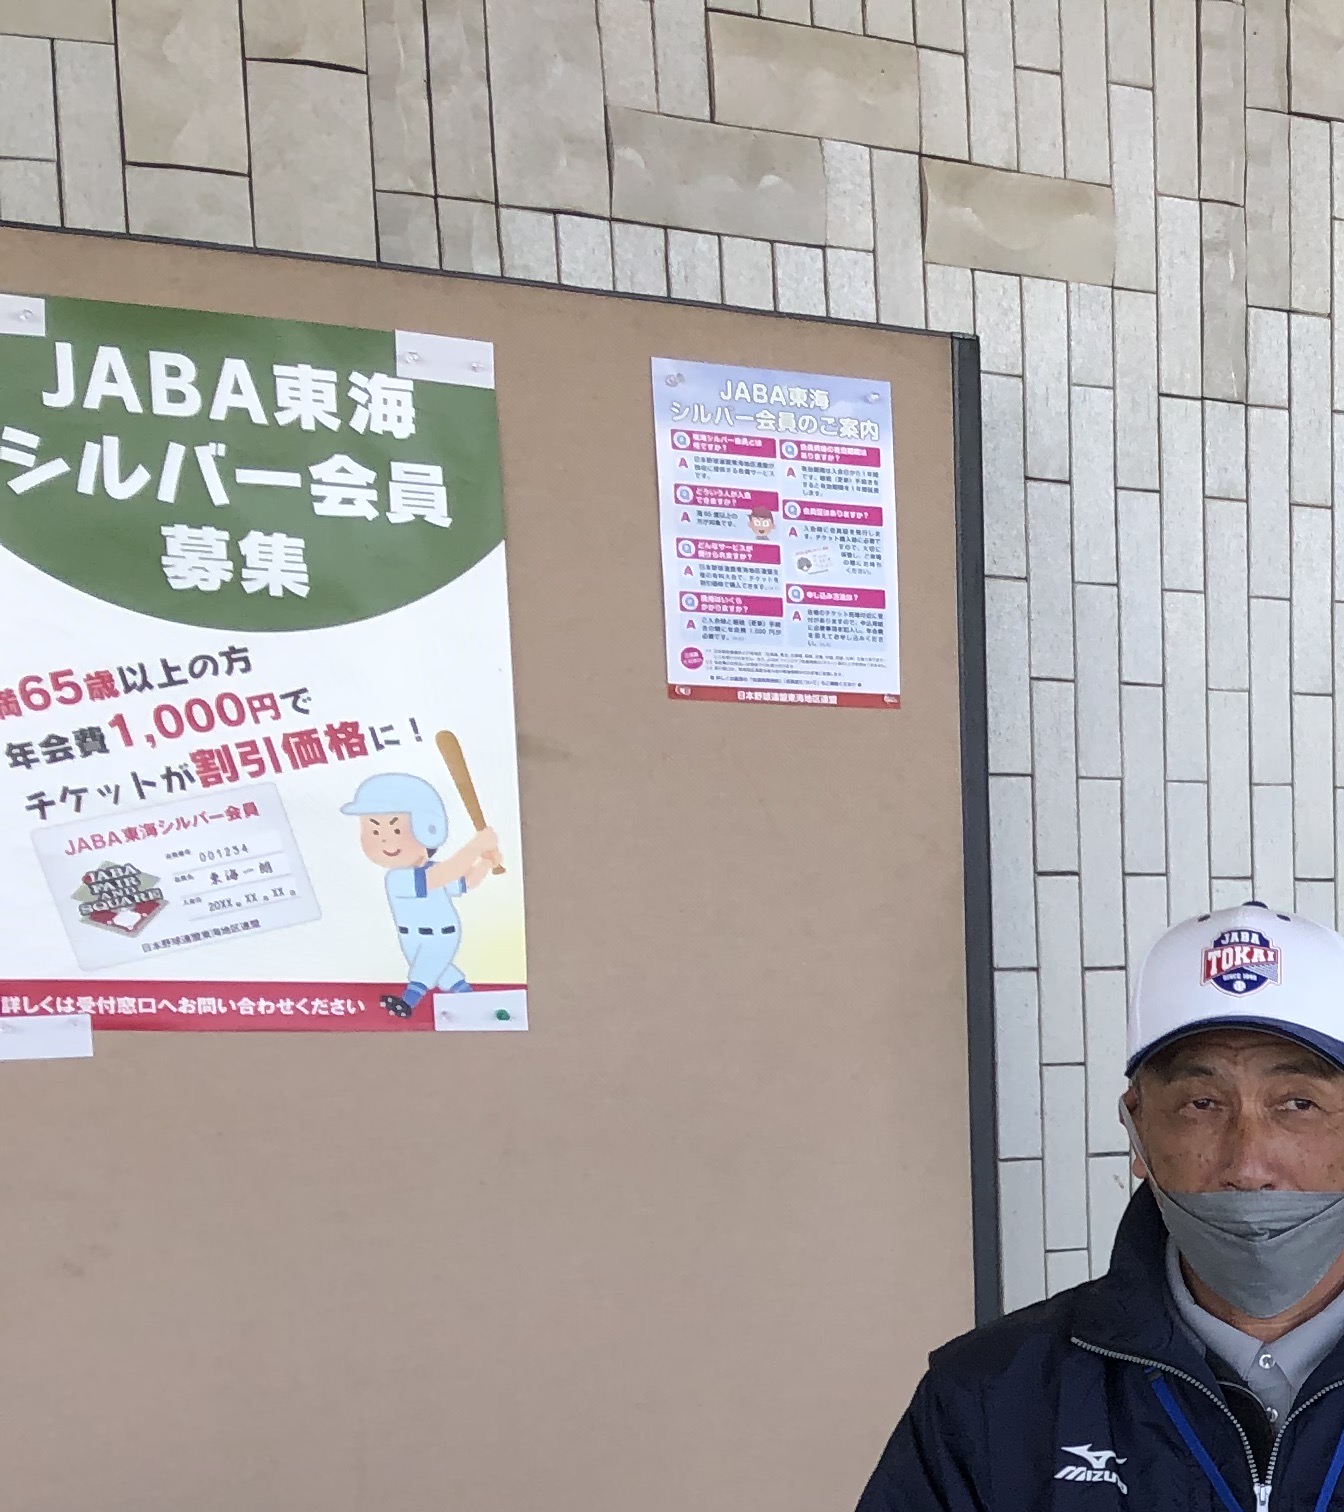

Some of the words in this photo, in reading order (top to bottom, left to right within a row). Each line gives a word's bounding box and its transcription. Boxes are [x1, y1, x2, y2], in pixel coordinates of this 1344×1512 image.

[42, 341, 416, 439] JABA東海
[720, 380, 830, 411] JABA東海
[670, 401, 879, 441] シルバー会員のご案内
[0, 426, 453, 528] シルバー会員
[160, 523, 310, 598] 募集
[5, 687, 313, 770] 年会費1,000円で
[1207, 945, 1275, 977] TOKAI
[1221, 931, 1260, 945] JABA
